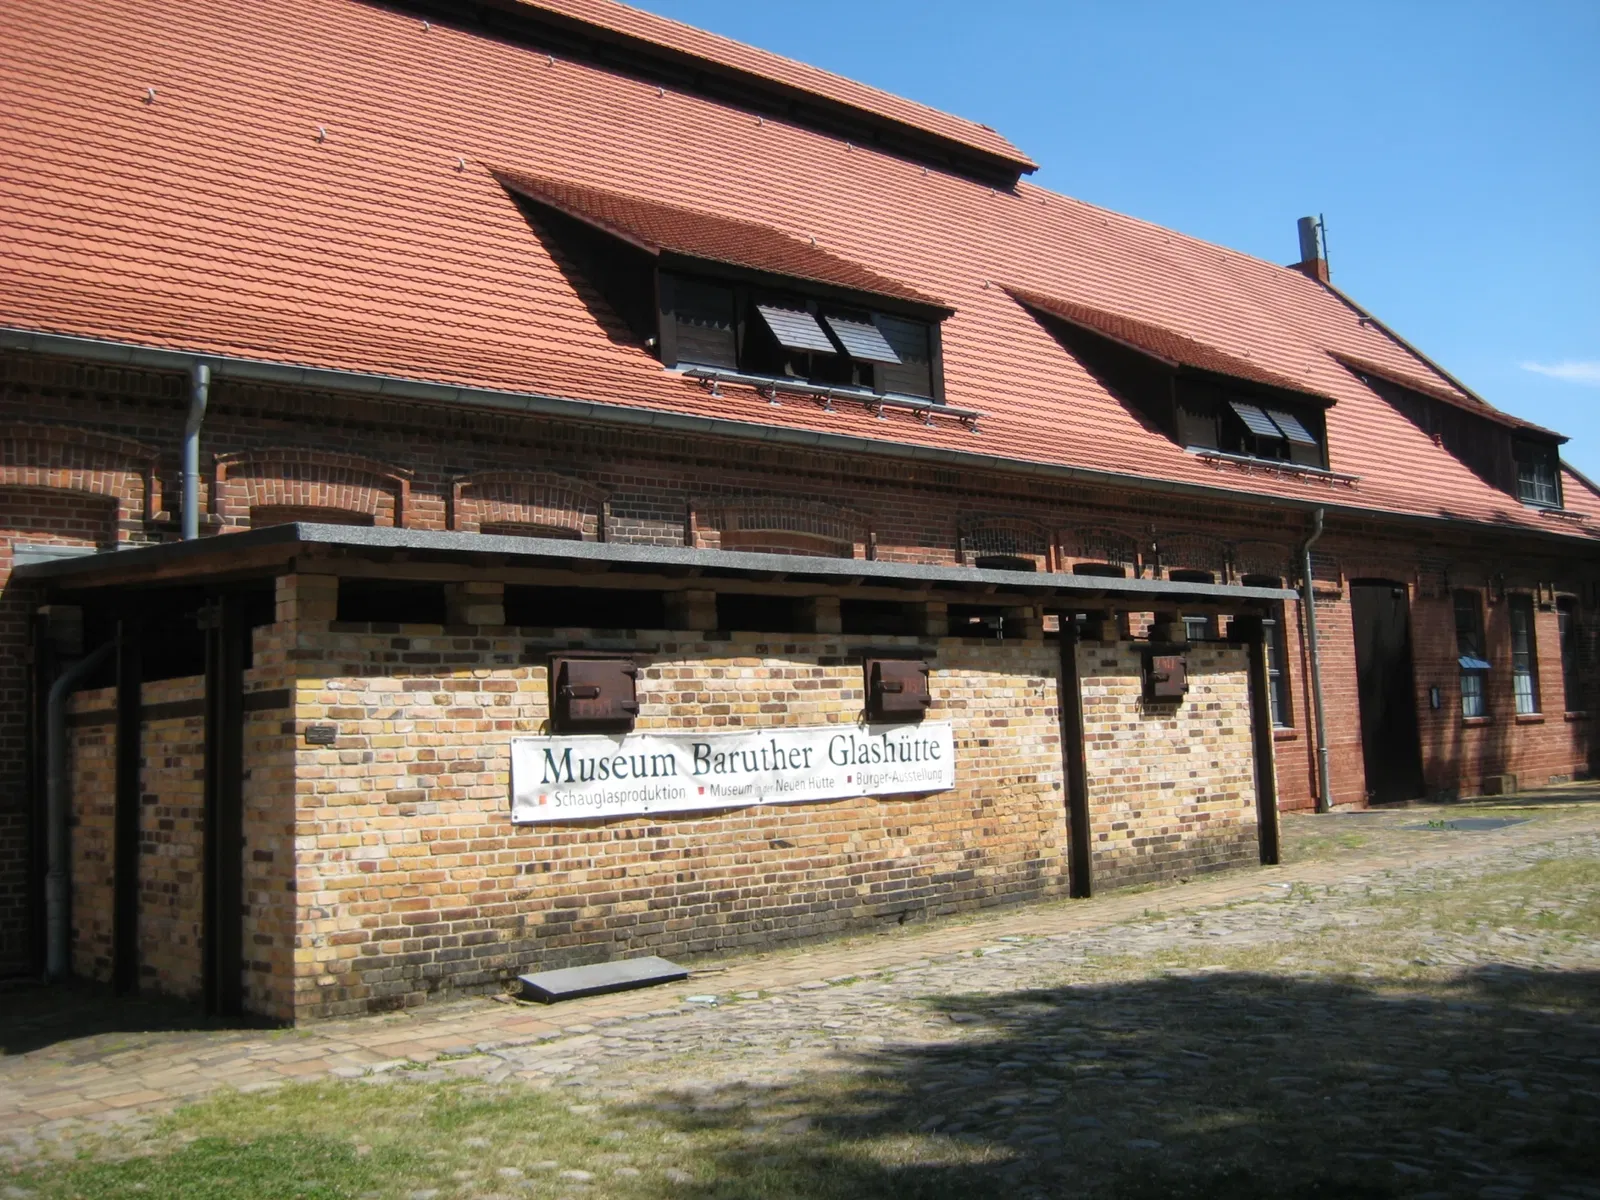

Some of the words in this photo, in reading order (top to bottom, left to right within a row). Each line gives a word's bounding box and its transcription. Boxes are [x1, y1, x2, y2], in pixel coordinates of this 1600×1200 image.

[541, 747, 677, 784] Museum
[692, 740, 813, 776] Baruther
[828, 734, 942, 766] Glashütte
[555, 785, 686, 808] Schauglasproduktion
[710, 783, 753, 797] Museum
[775, 778, 806, 792] Neuen
